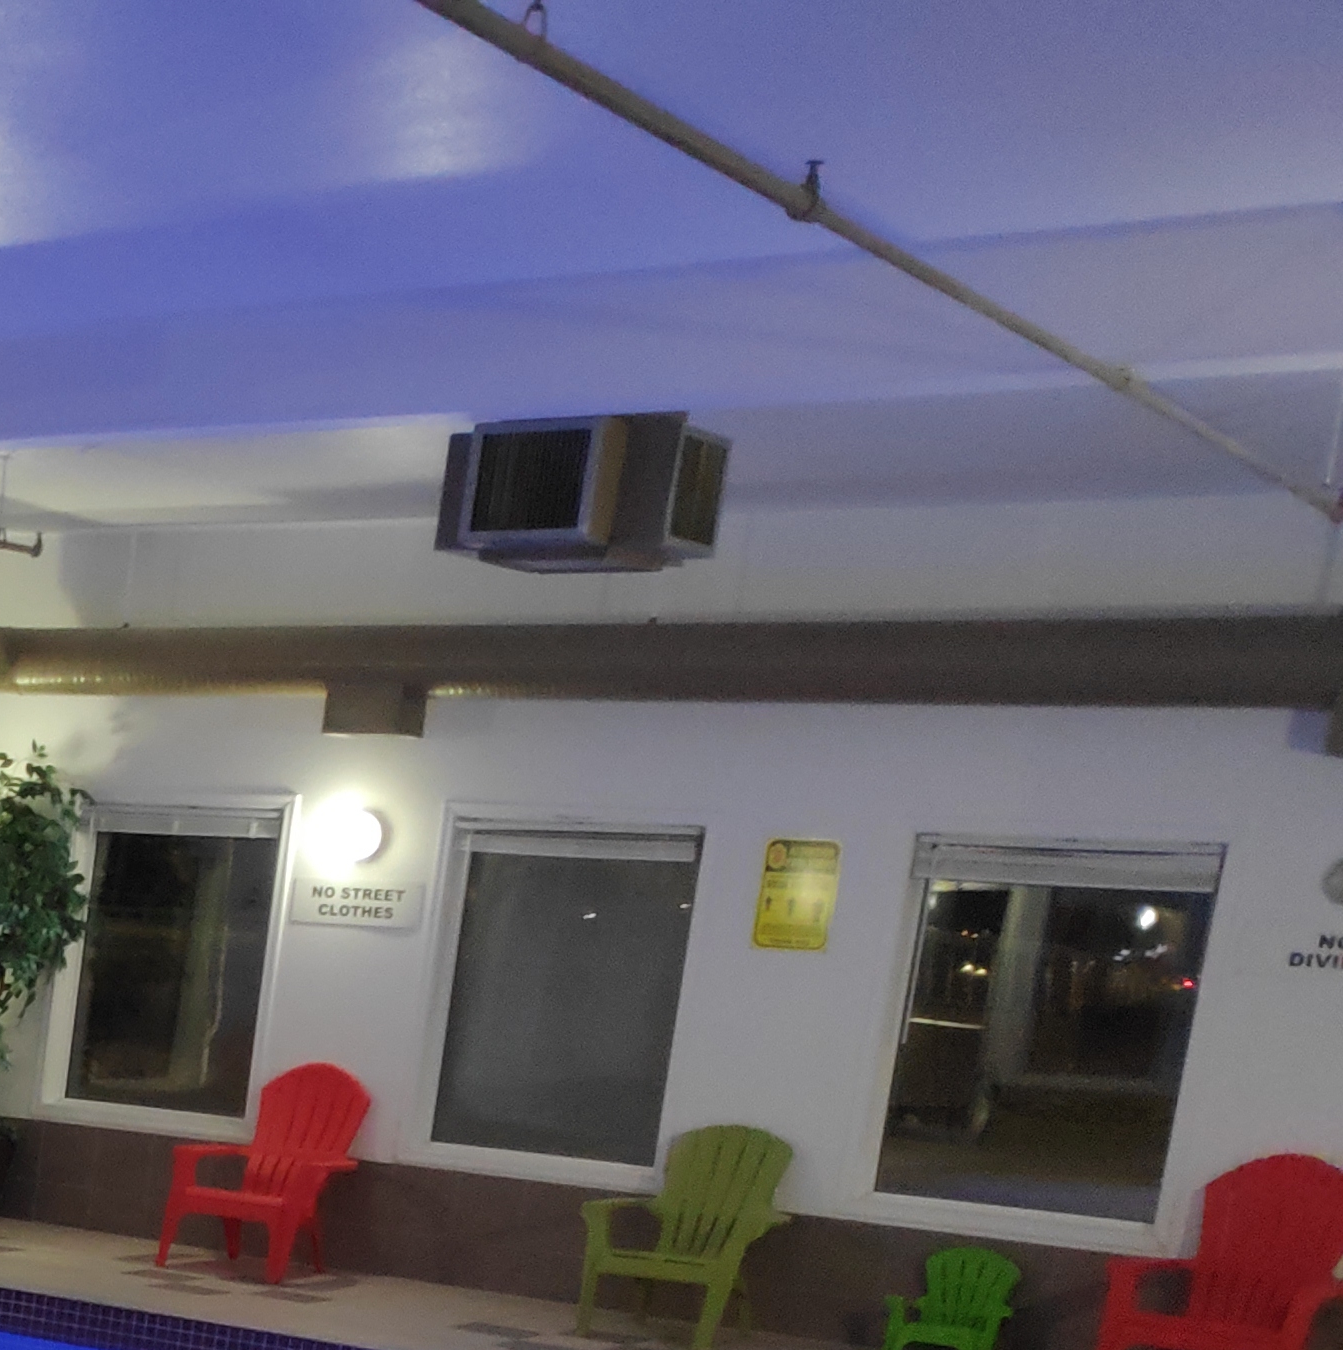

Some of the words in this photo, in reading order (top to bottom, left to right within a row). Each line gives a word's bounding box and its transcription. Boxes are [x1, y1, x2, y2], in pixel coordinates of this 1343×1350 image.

[312, 886, 335, 899] NO
[340, 887, 406, 902] STREET
[318, 903, 394, 919] CLOTHES
[1289, 952, 1343, 969] DIVI
